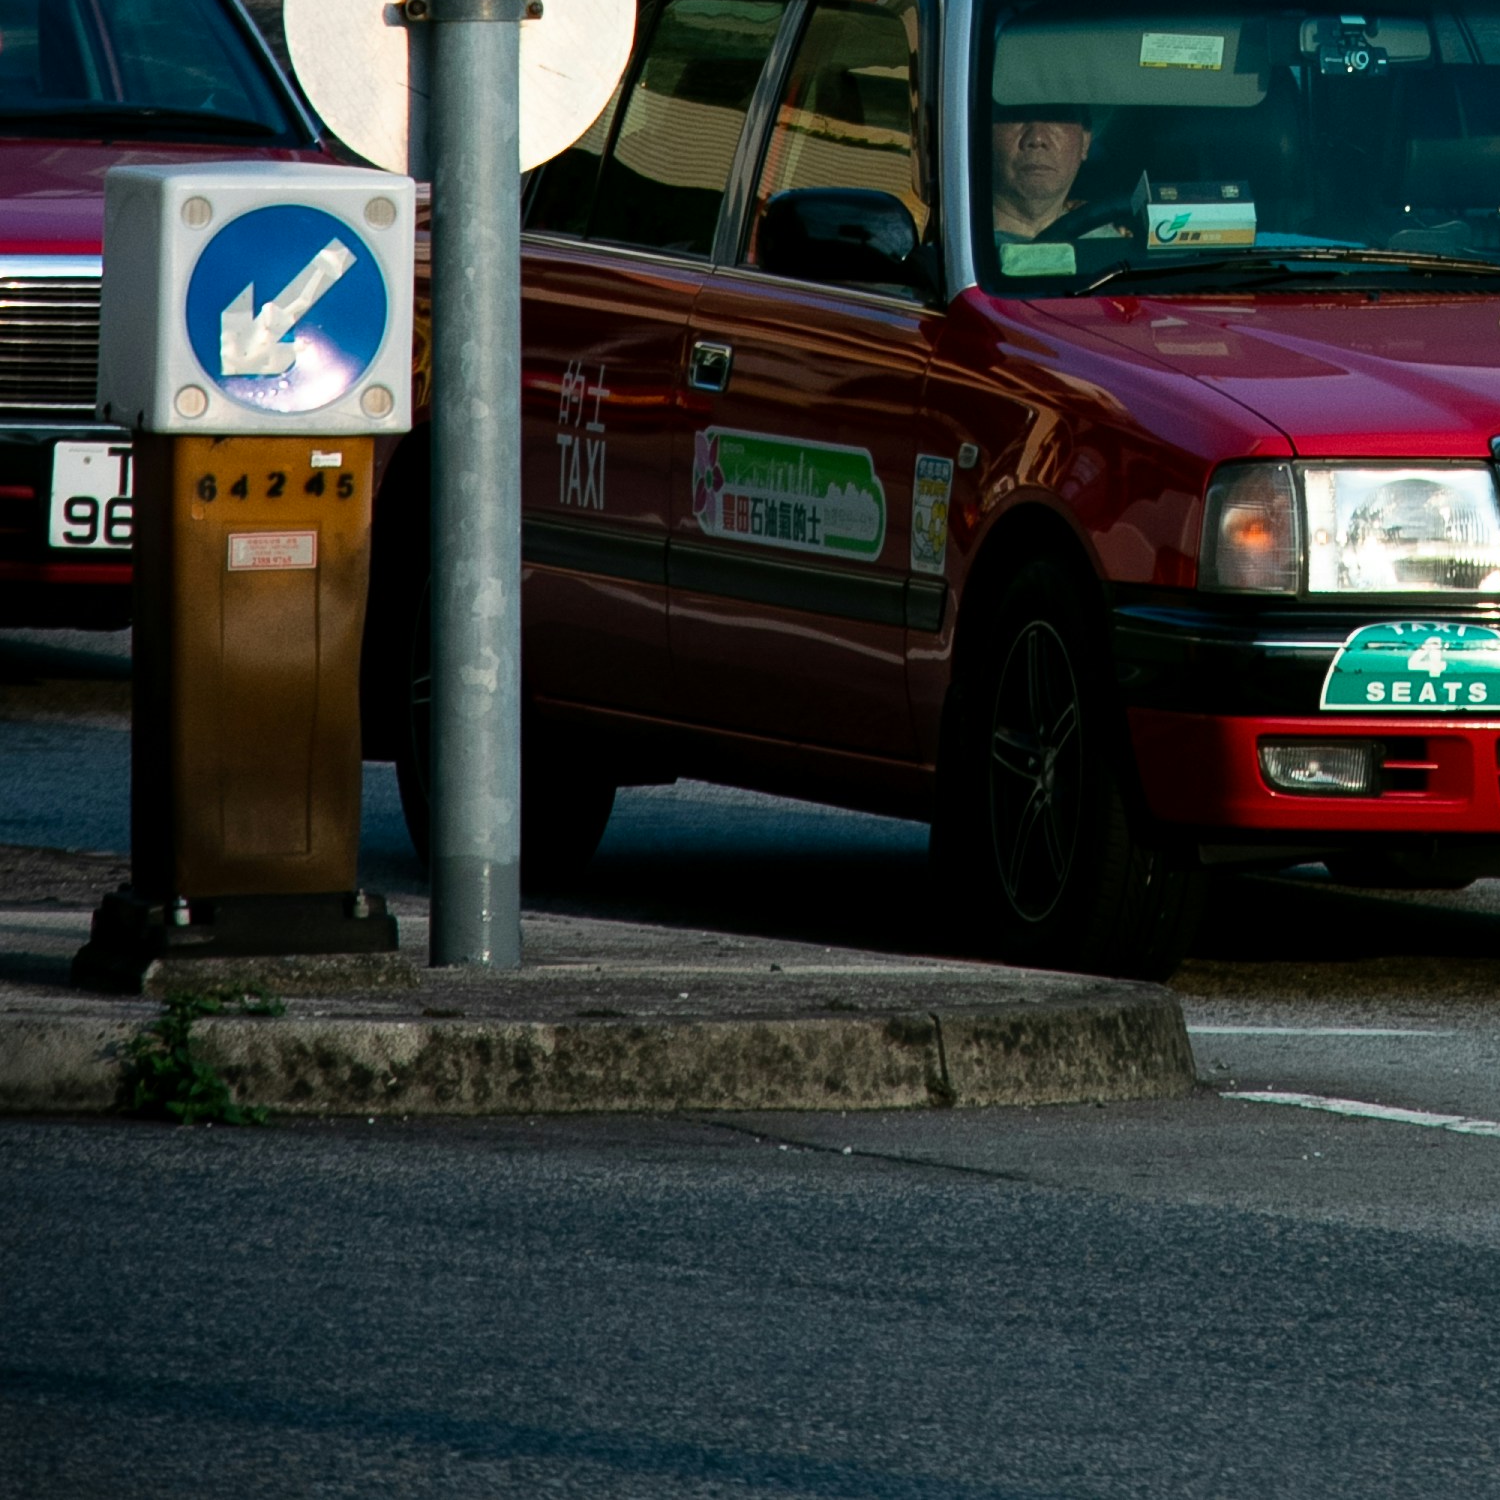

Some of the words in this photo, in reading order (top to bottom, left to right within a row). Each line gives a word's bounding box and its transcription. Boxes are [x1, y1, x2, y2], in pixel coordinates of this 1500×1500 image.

[558, 360, 611, 433] 的士
[197, 471, 355, 502] 64245
[556, 432, 606, 511] TAXI
[1407, 636, 1447, 678] 4
[1366, 681, 1488, 703] SEATS
